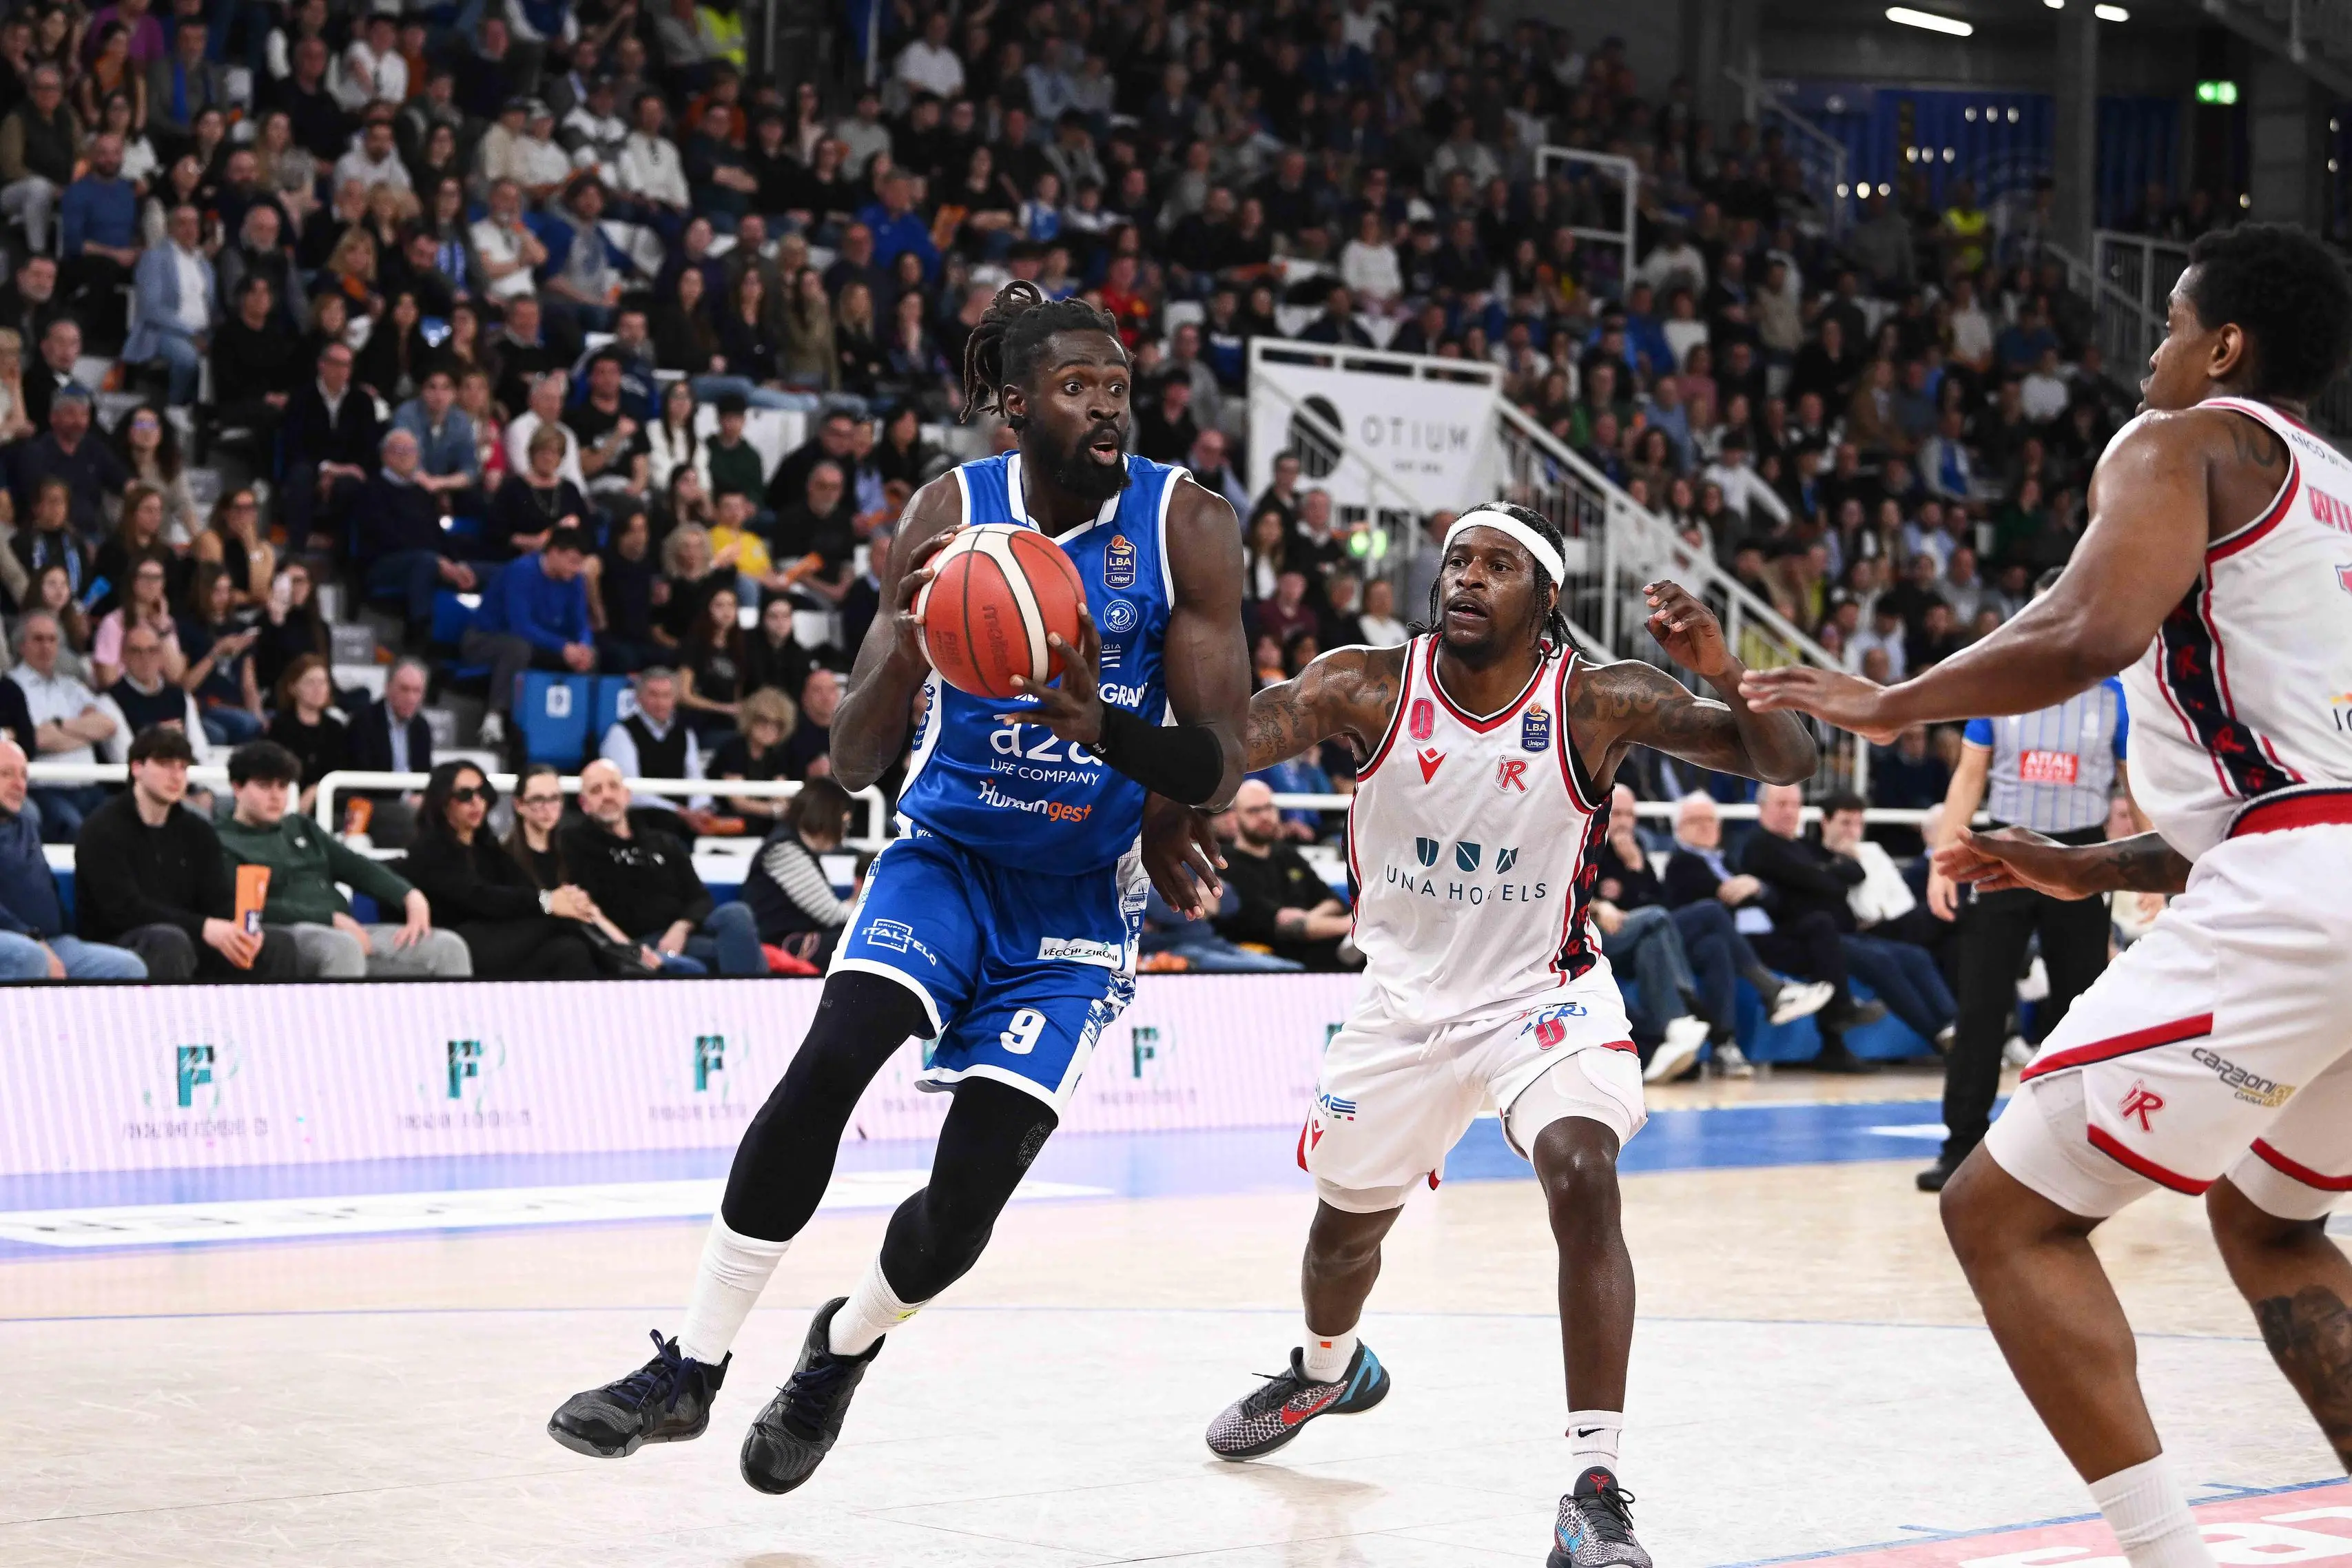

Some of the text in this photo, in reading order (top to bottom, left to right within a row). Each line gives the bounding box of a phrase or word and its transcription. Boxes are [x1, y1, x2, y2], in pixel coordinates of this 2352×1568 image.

[1360, 414, 1469, 453] OTIUM
[1109, 557, 1131, 566] LBA
[1111, 575, 1129, 584] Unipol
[1106, 602, 1135, 616] PALLACANESTRO
[1108, 621, 1133, 630] BRESCIA
[1408, 697, 1435, 741] 0
[1525, 723, 1547, 732] LBA
[990, 758, 1100, 785] LIFE COMPANY
[977, 778, 1093, 822] Humangest
[1386, 864, 1436, 897] UNA
[878, 922, 907, 933] GRUPPO
[1043, 948, 1117, 962] VECCHI ZIRONI
[1000, 1007, 1047, 1055] 9
